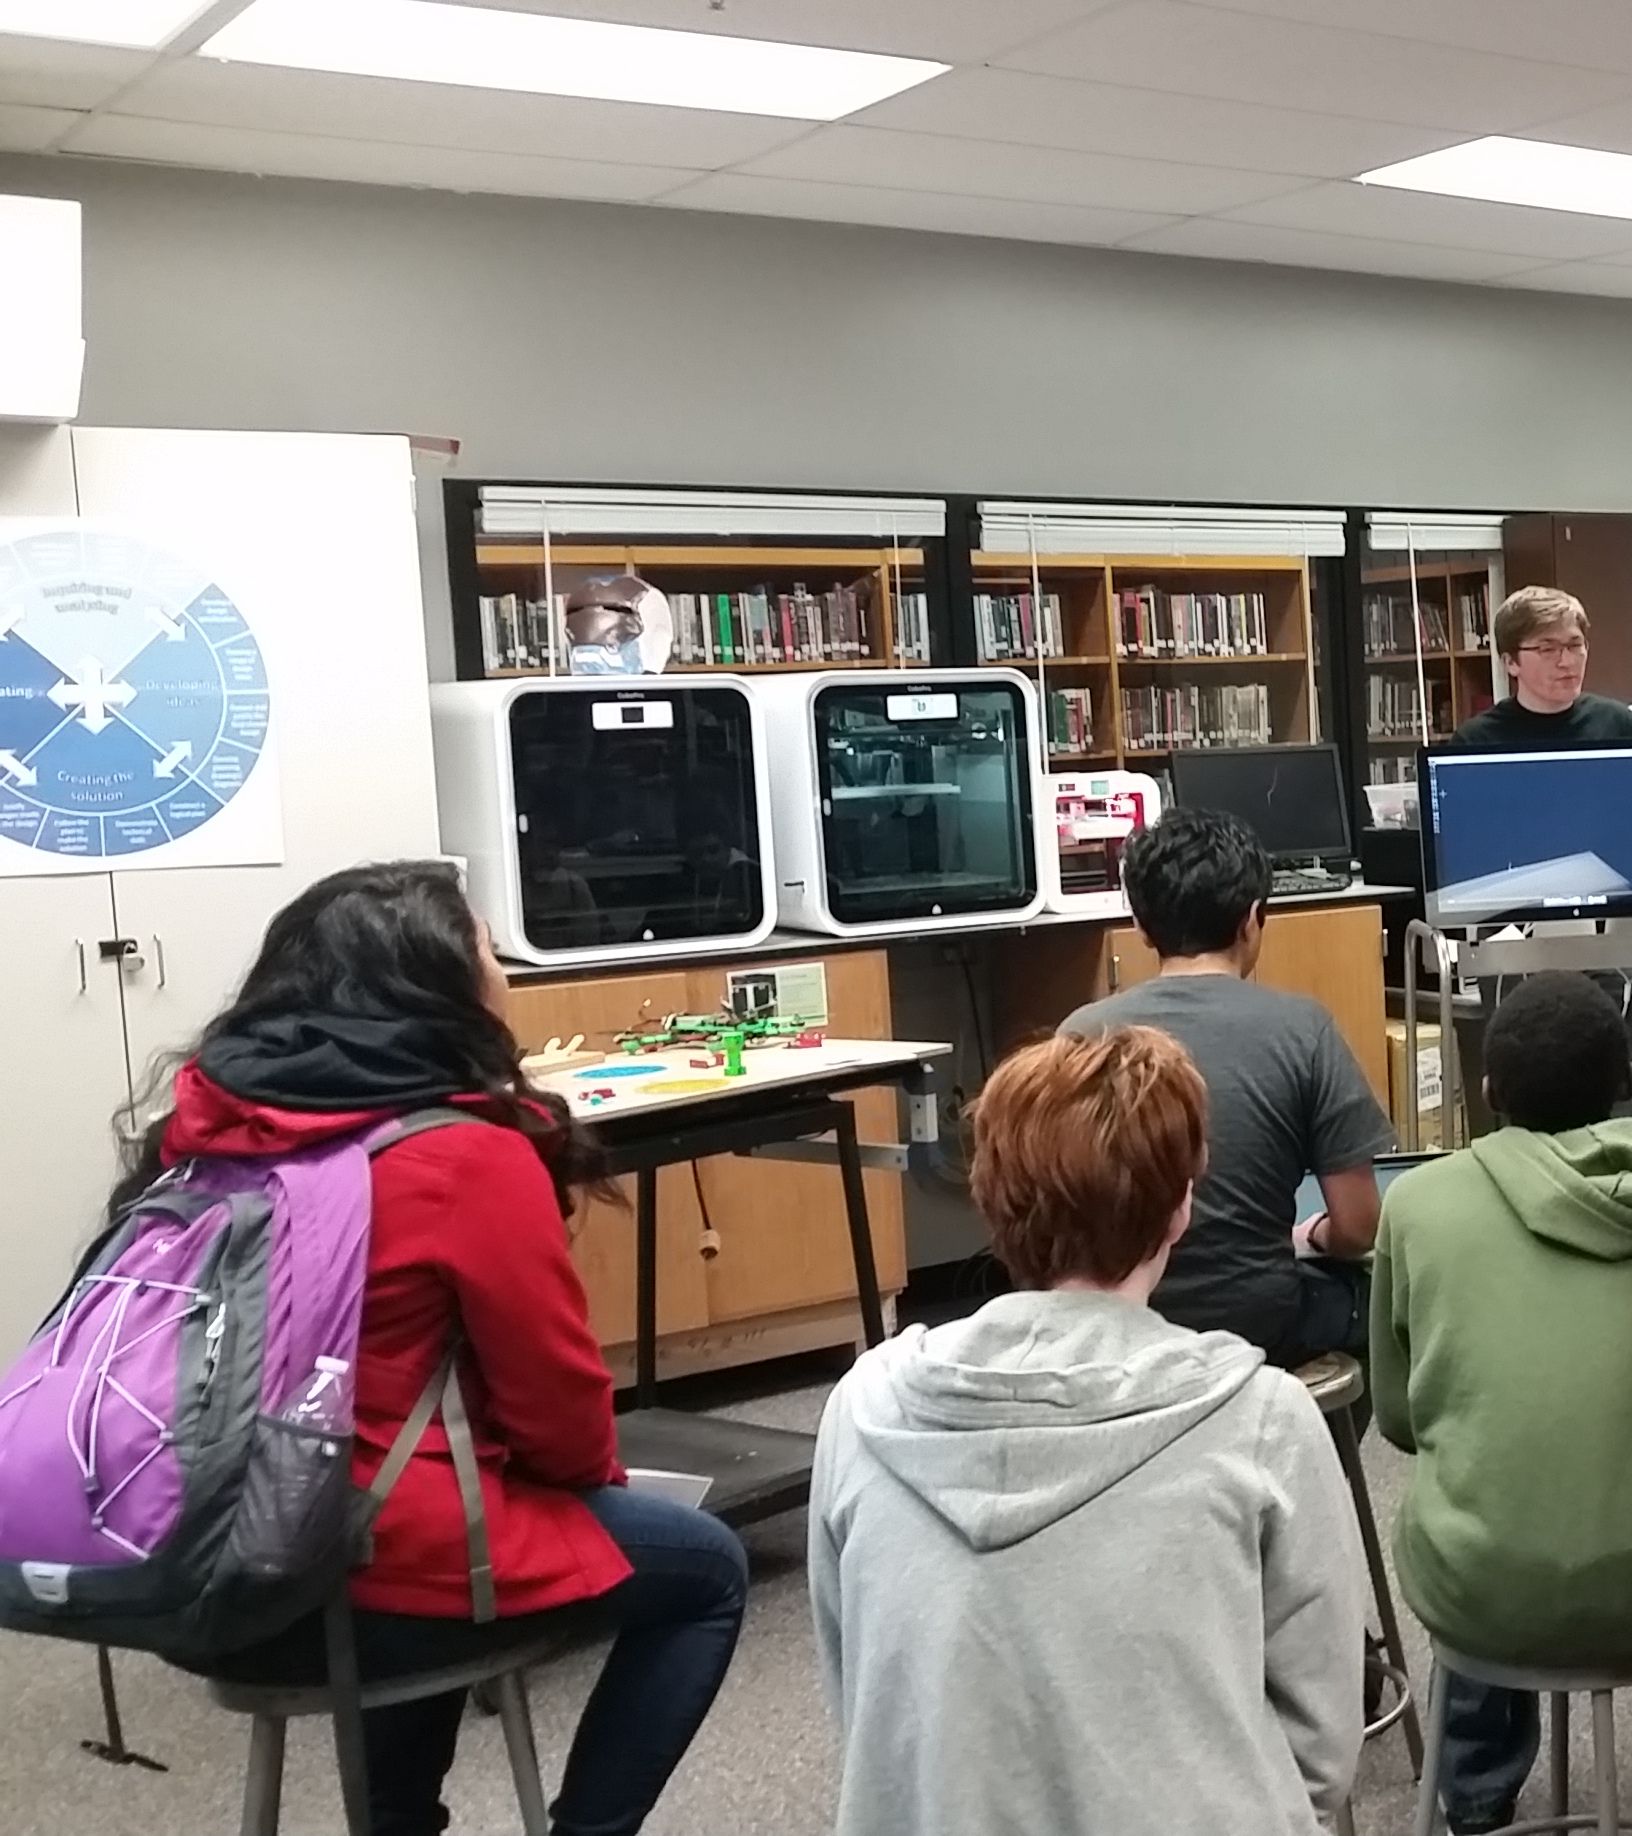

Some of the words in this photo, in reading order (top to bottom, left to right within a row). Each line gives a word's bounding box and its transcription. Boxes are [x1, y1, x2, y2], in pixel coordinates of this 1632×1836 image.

[57, 769, 112, 787] Creating
[112, 769, 134, 781] the
[70, 790, 124, 802] solution
